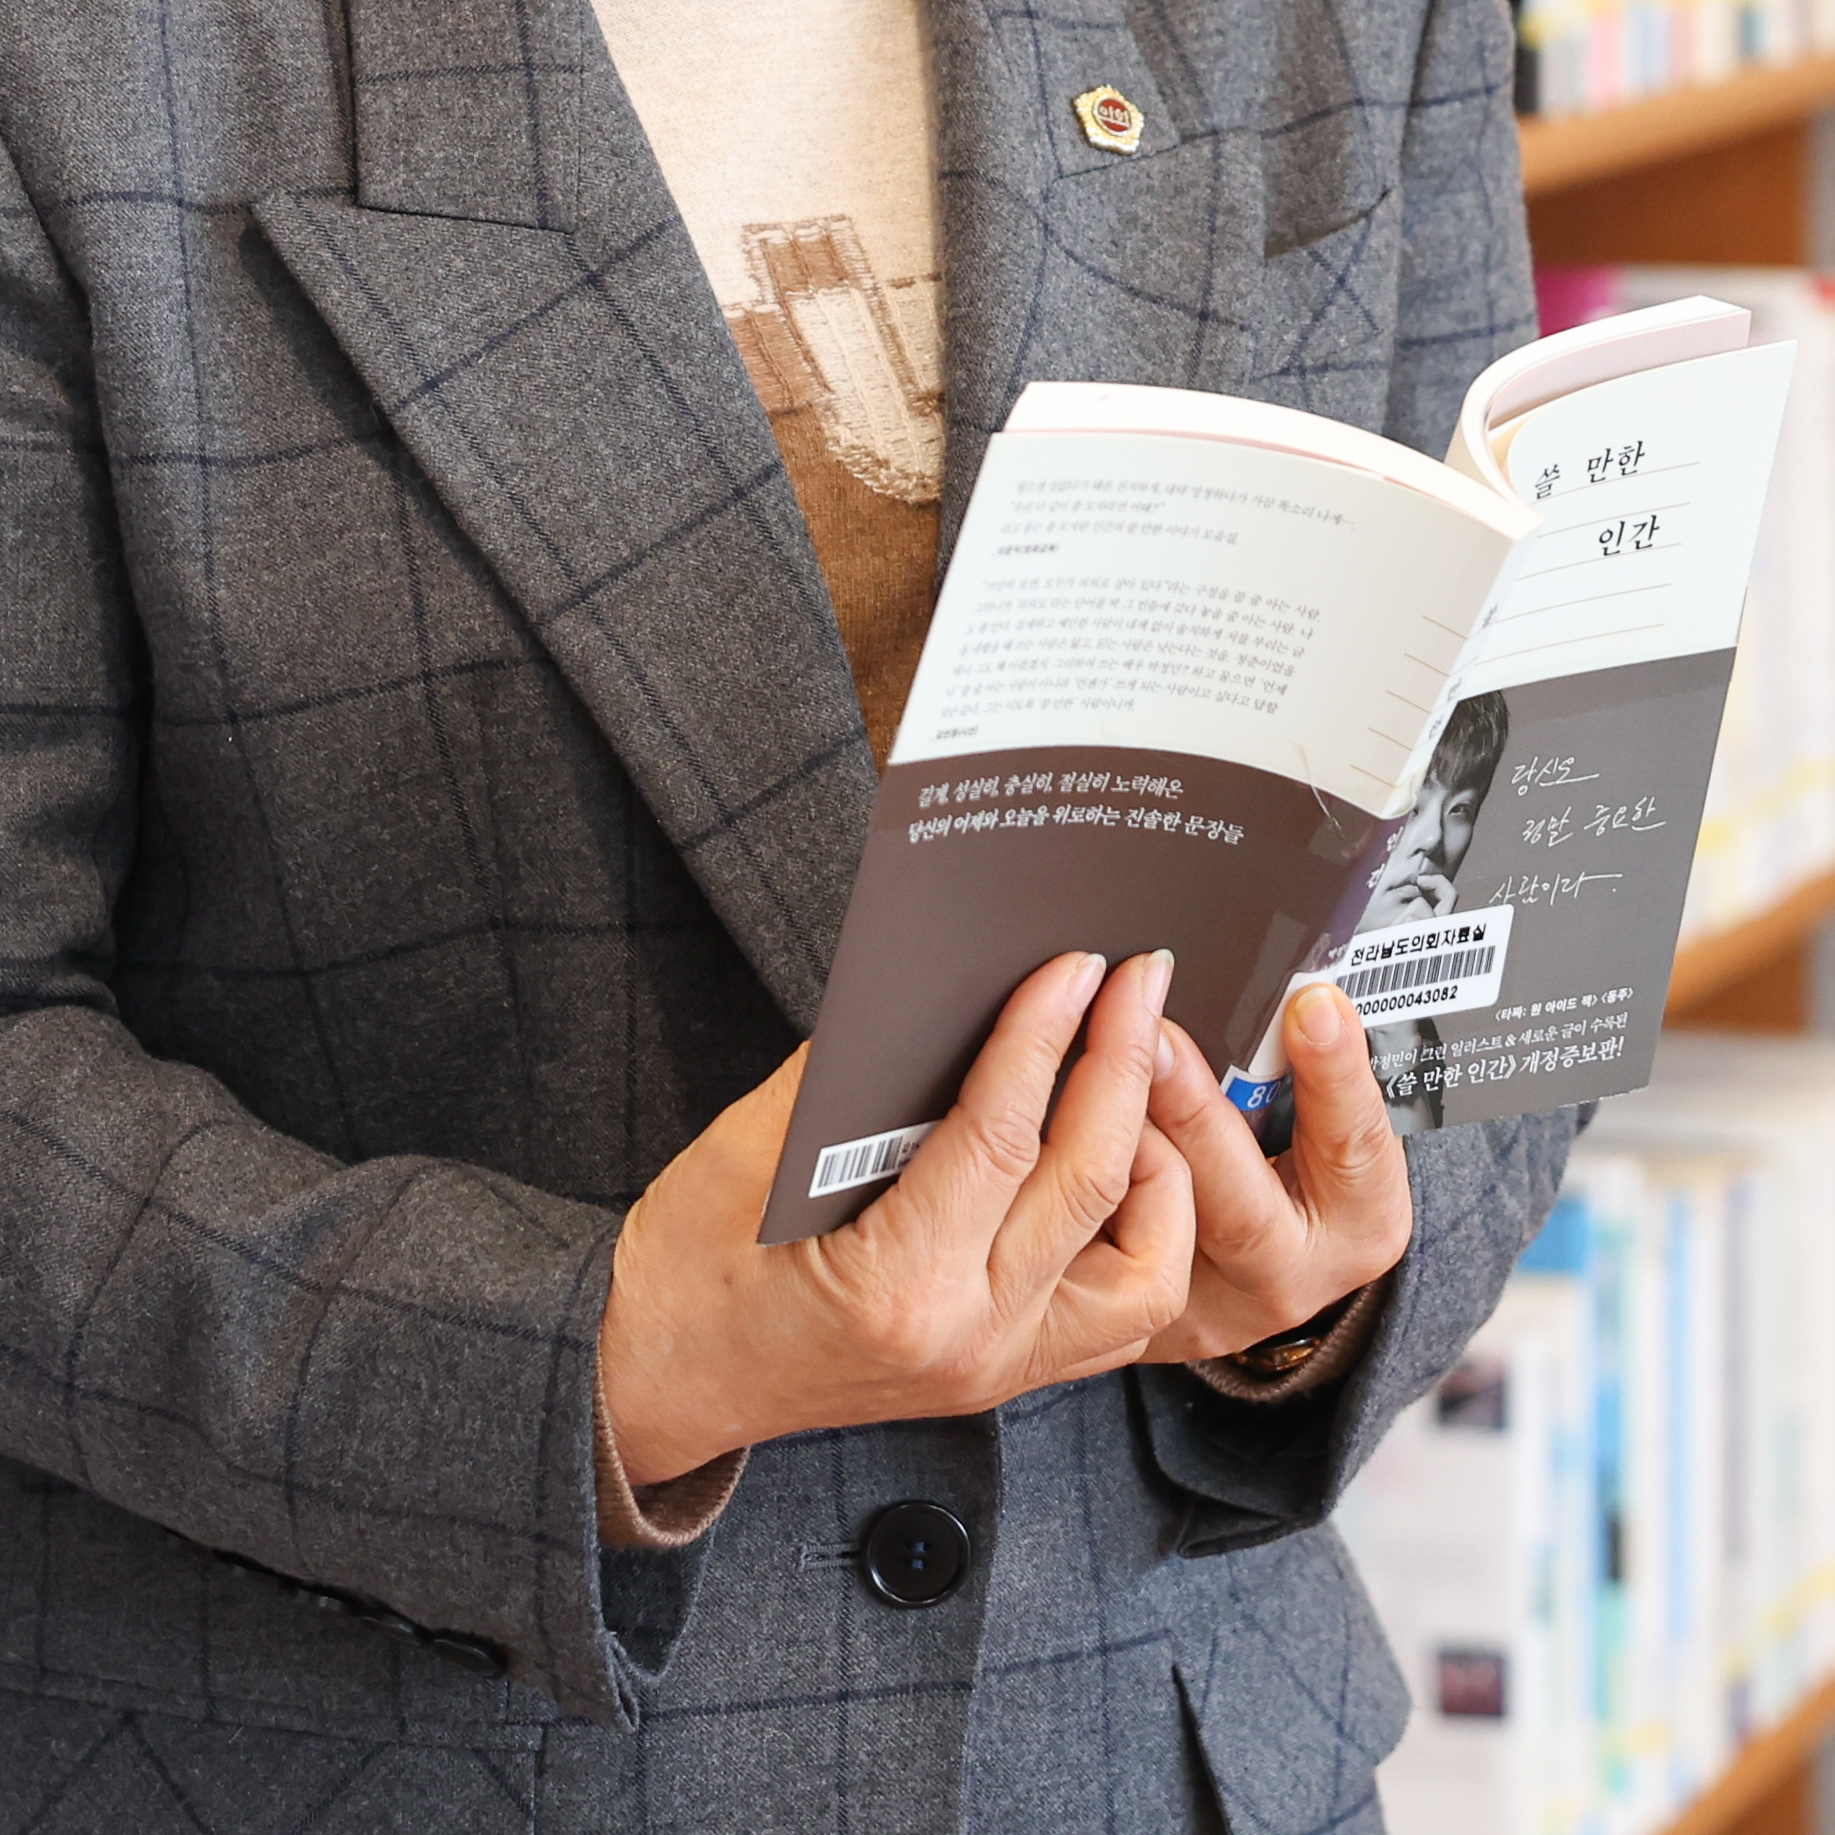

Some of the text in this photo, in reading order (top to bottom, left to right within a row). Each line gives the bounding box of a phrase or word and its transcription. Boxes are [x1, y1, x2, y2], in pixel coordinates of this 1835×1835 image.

[1534, 440, 1646, 500] 쓸 만한
[1598, 514, 1660, 557] 인간
[1110, 774, 1184, 800] 노력해온
[1051, 805, 1122, 827] 위로하는
[1123, 808, 1182, 833] 진솔한
[1183, 814, 1245, 846] 문장들
[1350, 923, 1487, 967] 전라남도의회자료실
[1450, 1035, 1503, 1055] 일러스트
[1518, 1027, 1558, 1045] 새로운
[1423, 1066, 1463, 1093] 만한
[1519, 1037, 1625, 1075] 개정증보판!
